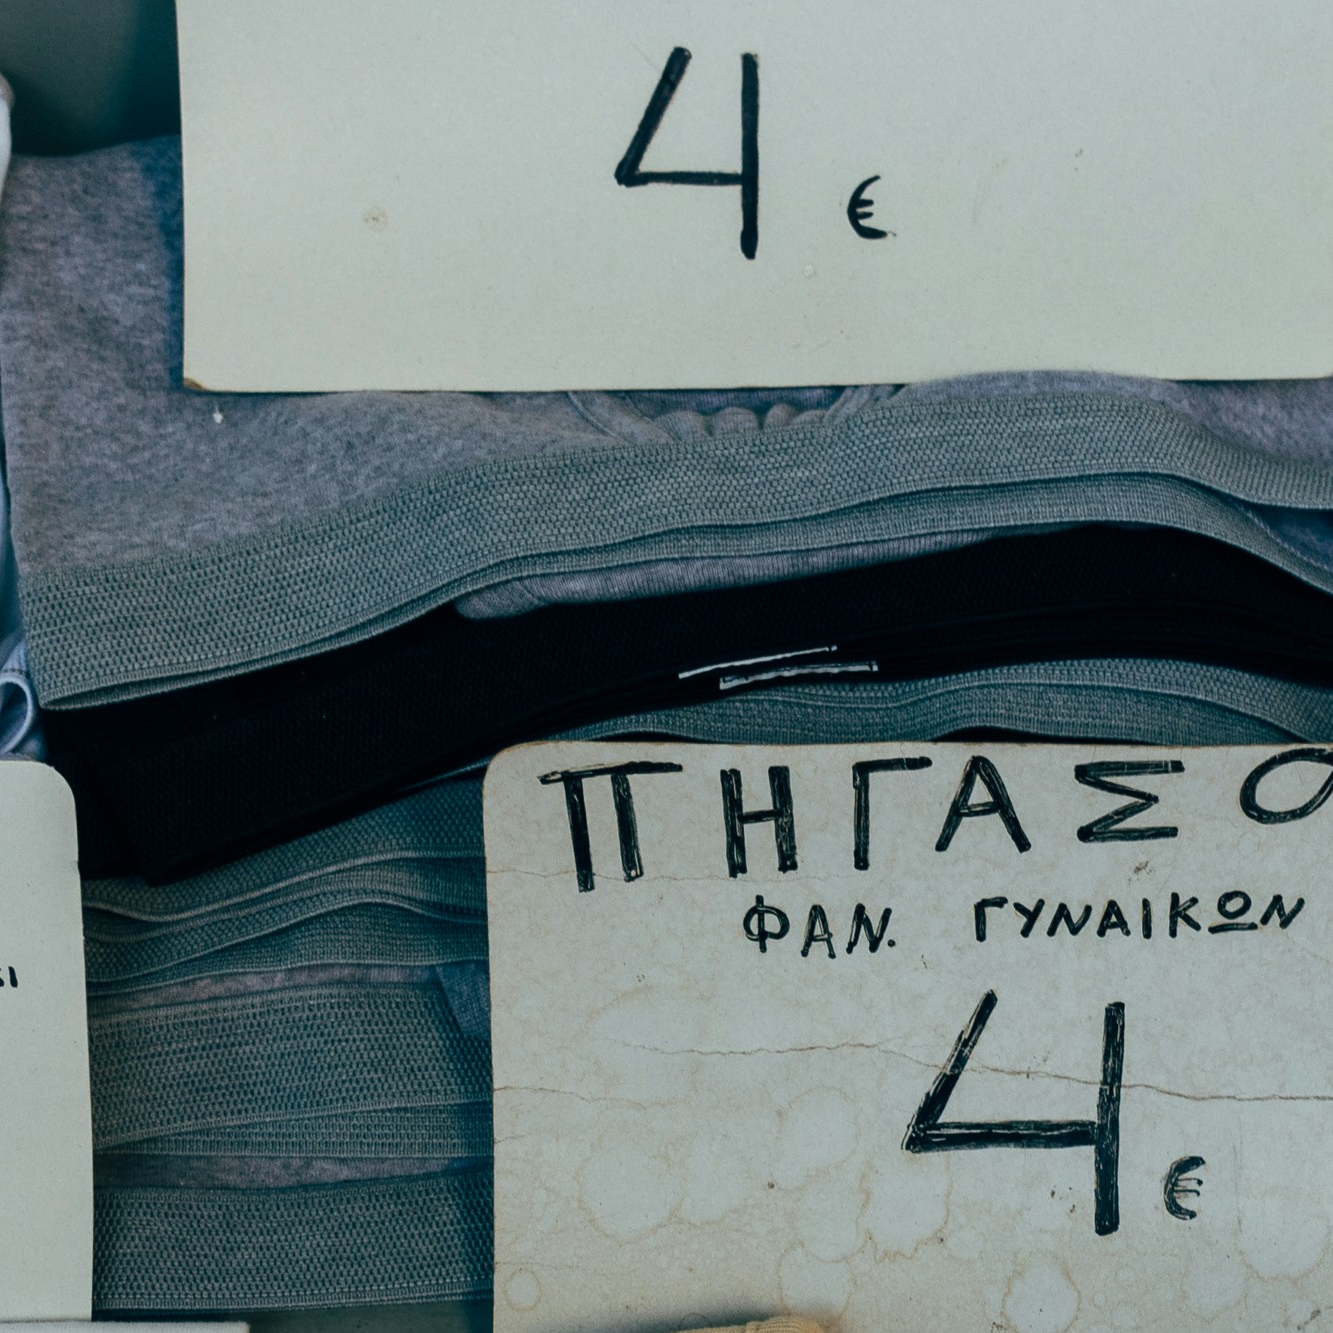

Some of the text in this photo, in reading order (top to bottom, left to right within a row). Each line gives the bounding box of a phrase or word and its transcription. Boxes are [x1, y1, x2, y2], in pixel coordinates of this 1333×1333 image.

[613, 46, 898, 260] 4 €
[741, 894, 897, 960] ΦΑΝ.
[900, 988, 1126, 1236] 4
